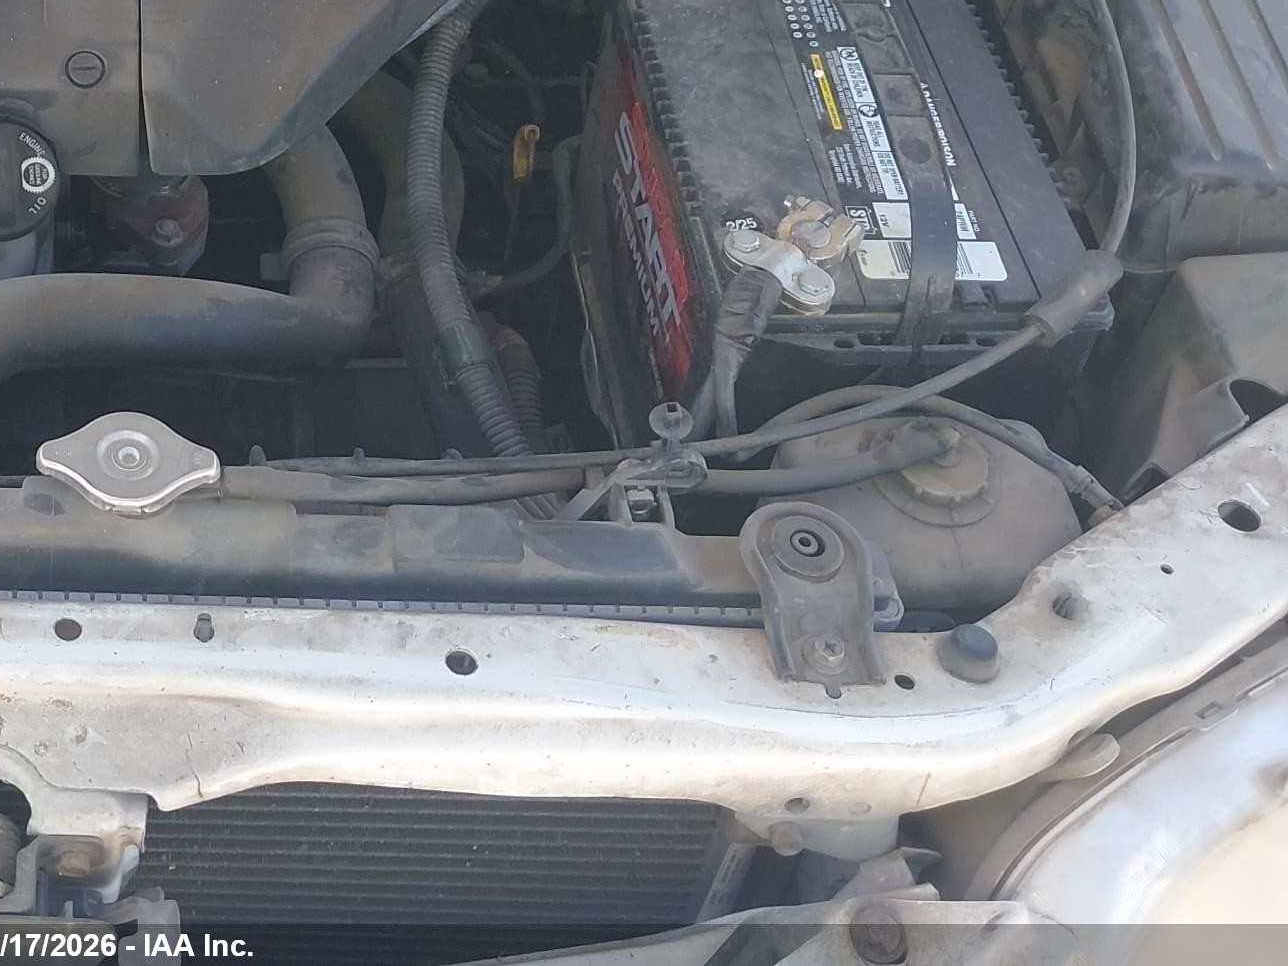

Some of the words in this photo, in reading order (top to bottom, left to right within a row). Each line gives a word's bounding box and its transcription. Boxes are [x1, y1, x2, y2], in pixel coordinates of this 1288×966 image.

[18, 132, 46, 158] ENGINE
[28, 196, 47, 214] OIL
[614, 111, 681, 328] START
[725, 217, 758, 232] 2/25
[612, 168, 660, 337] PREMIUM
